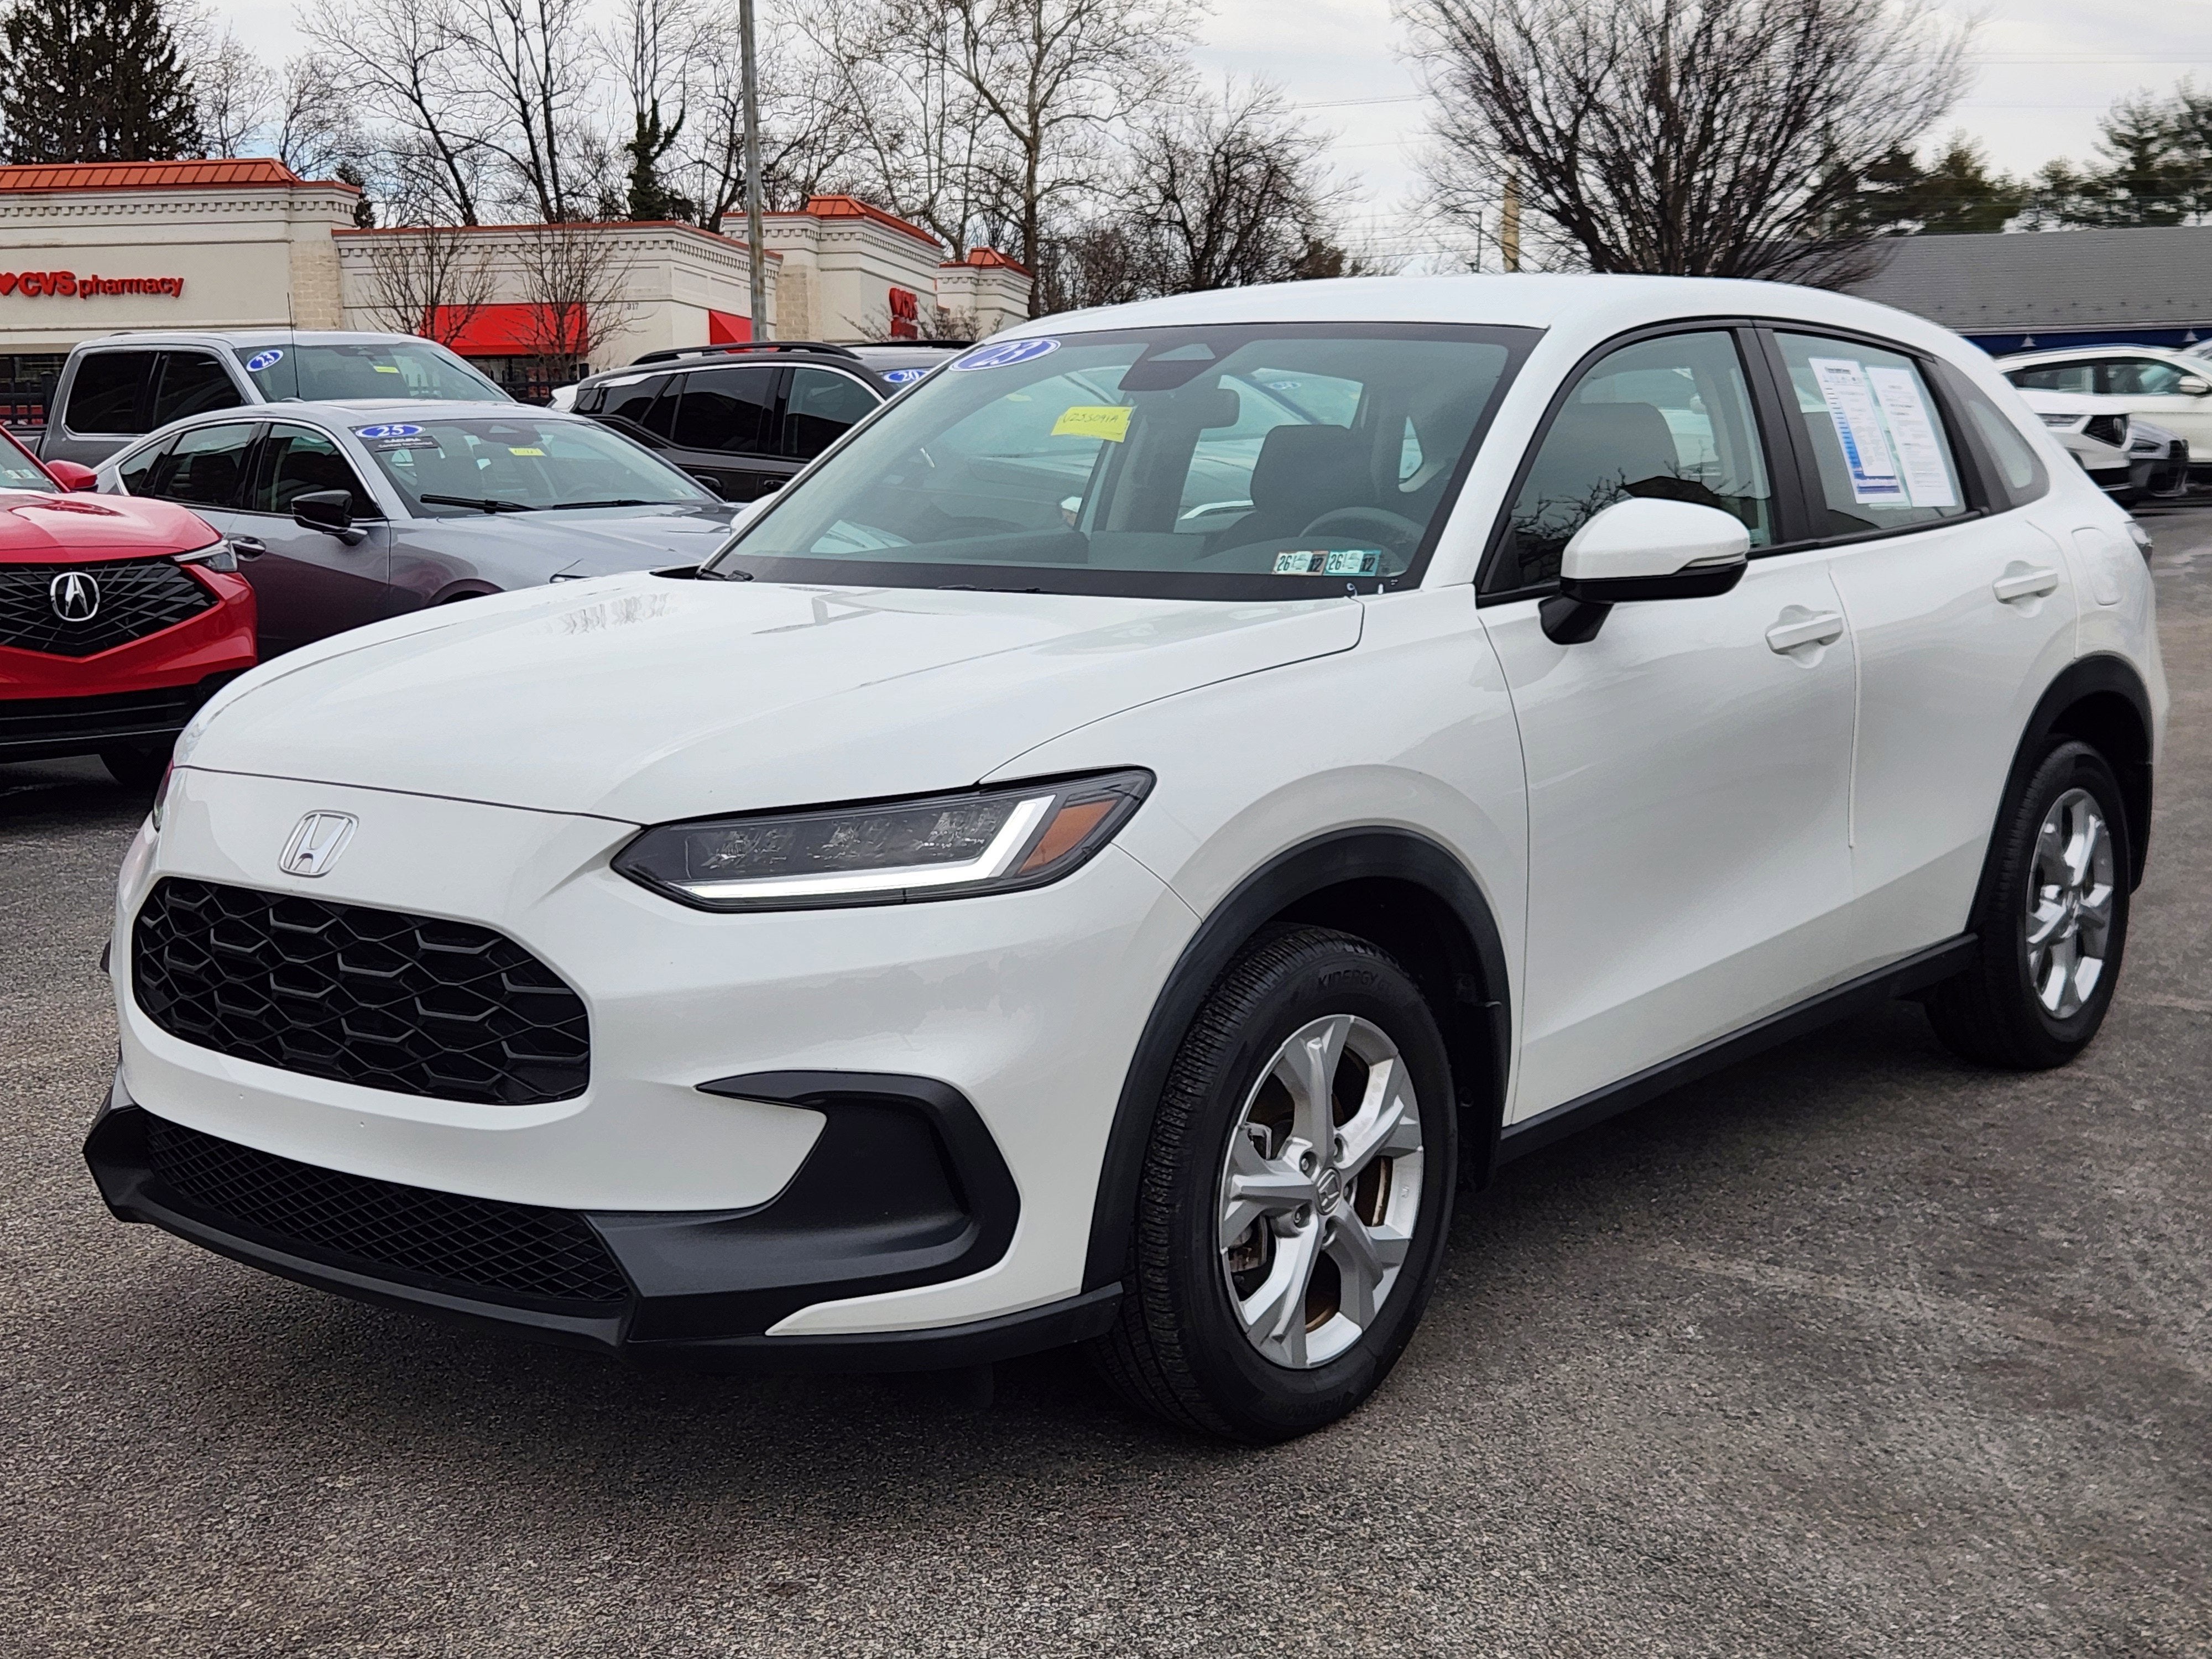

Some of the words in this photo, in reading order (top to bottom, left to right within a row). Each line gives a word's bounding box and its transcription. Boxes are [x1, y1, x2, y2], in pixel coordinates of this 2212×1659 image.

[18, 271, 77, 297] CVS
[79, 275, 184, 299] pharmacy
[968, 340, 1043, 368] 23
[376, 425, 405, 437] 25
[1276, 555, 1292, 571] 26
[1307, 557, 1324, 572] 12
[1328, 554, 1344, 571] 26
[1361, 557, 1376, 572] 12
